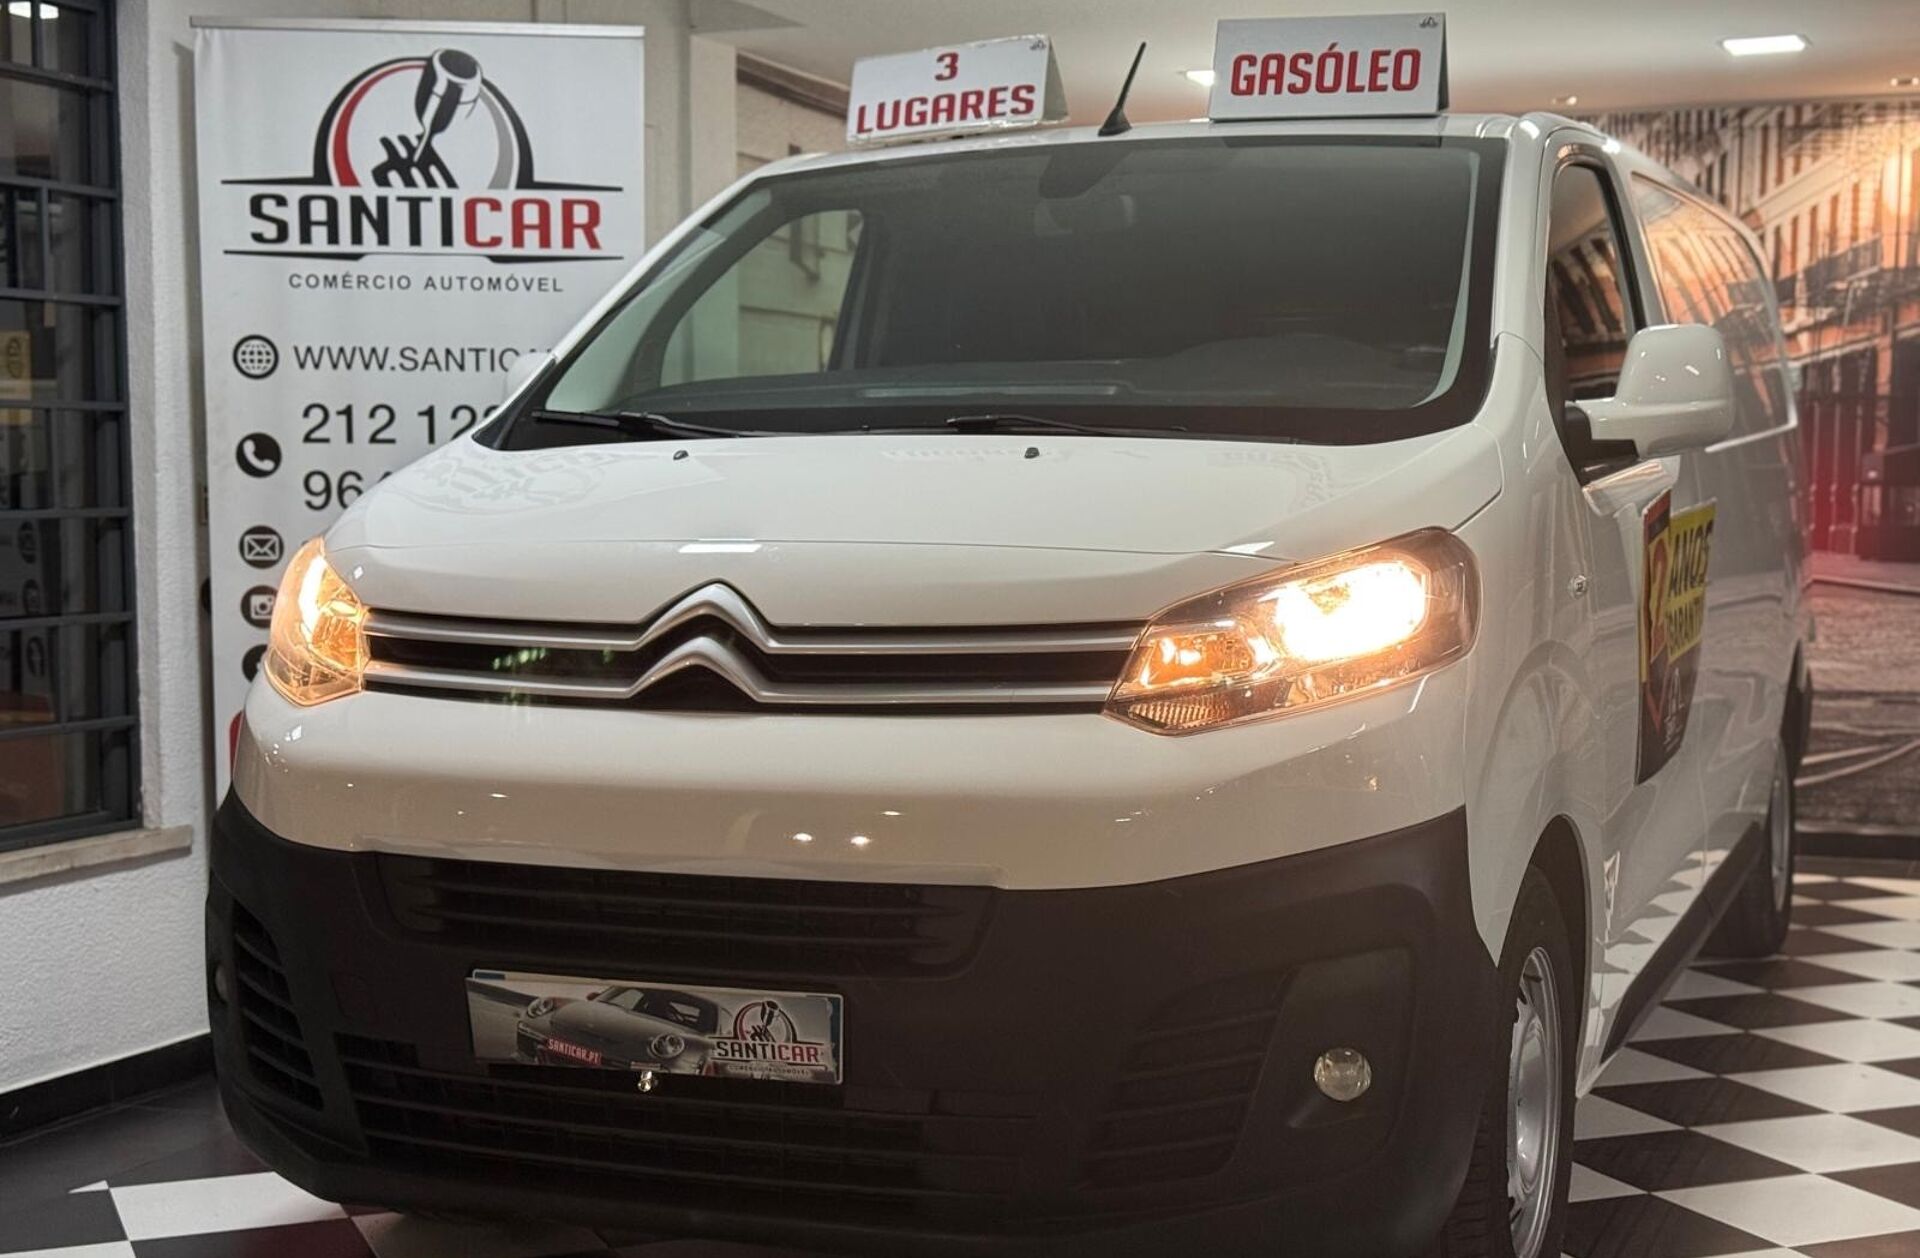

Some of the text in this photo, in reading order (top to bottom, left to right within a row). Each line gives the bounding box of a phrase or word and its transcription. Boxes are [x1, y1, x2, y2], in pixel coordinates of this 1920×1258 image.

[935, 52, 959, 81] 3
[1230, 42, 1421, 96] GASÓLEO
[857, 84, 1036, 134] LUGARES
[249, 193, 602, 250] SANTICAR
[288, 271, 564, 293] COMÉRCIO AUTOMÓVEL
[294, 345, 552, 372] WWW.SANTIC
[302, 403, 396, 444] 212
[303, 470, 393, 511] 96
[716, 1041, 819, 1063] SANTICAR
